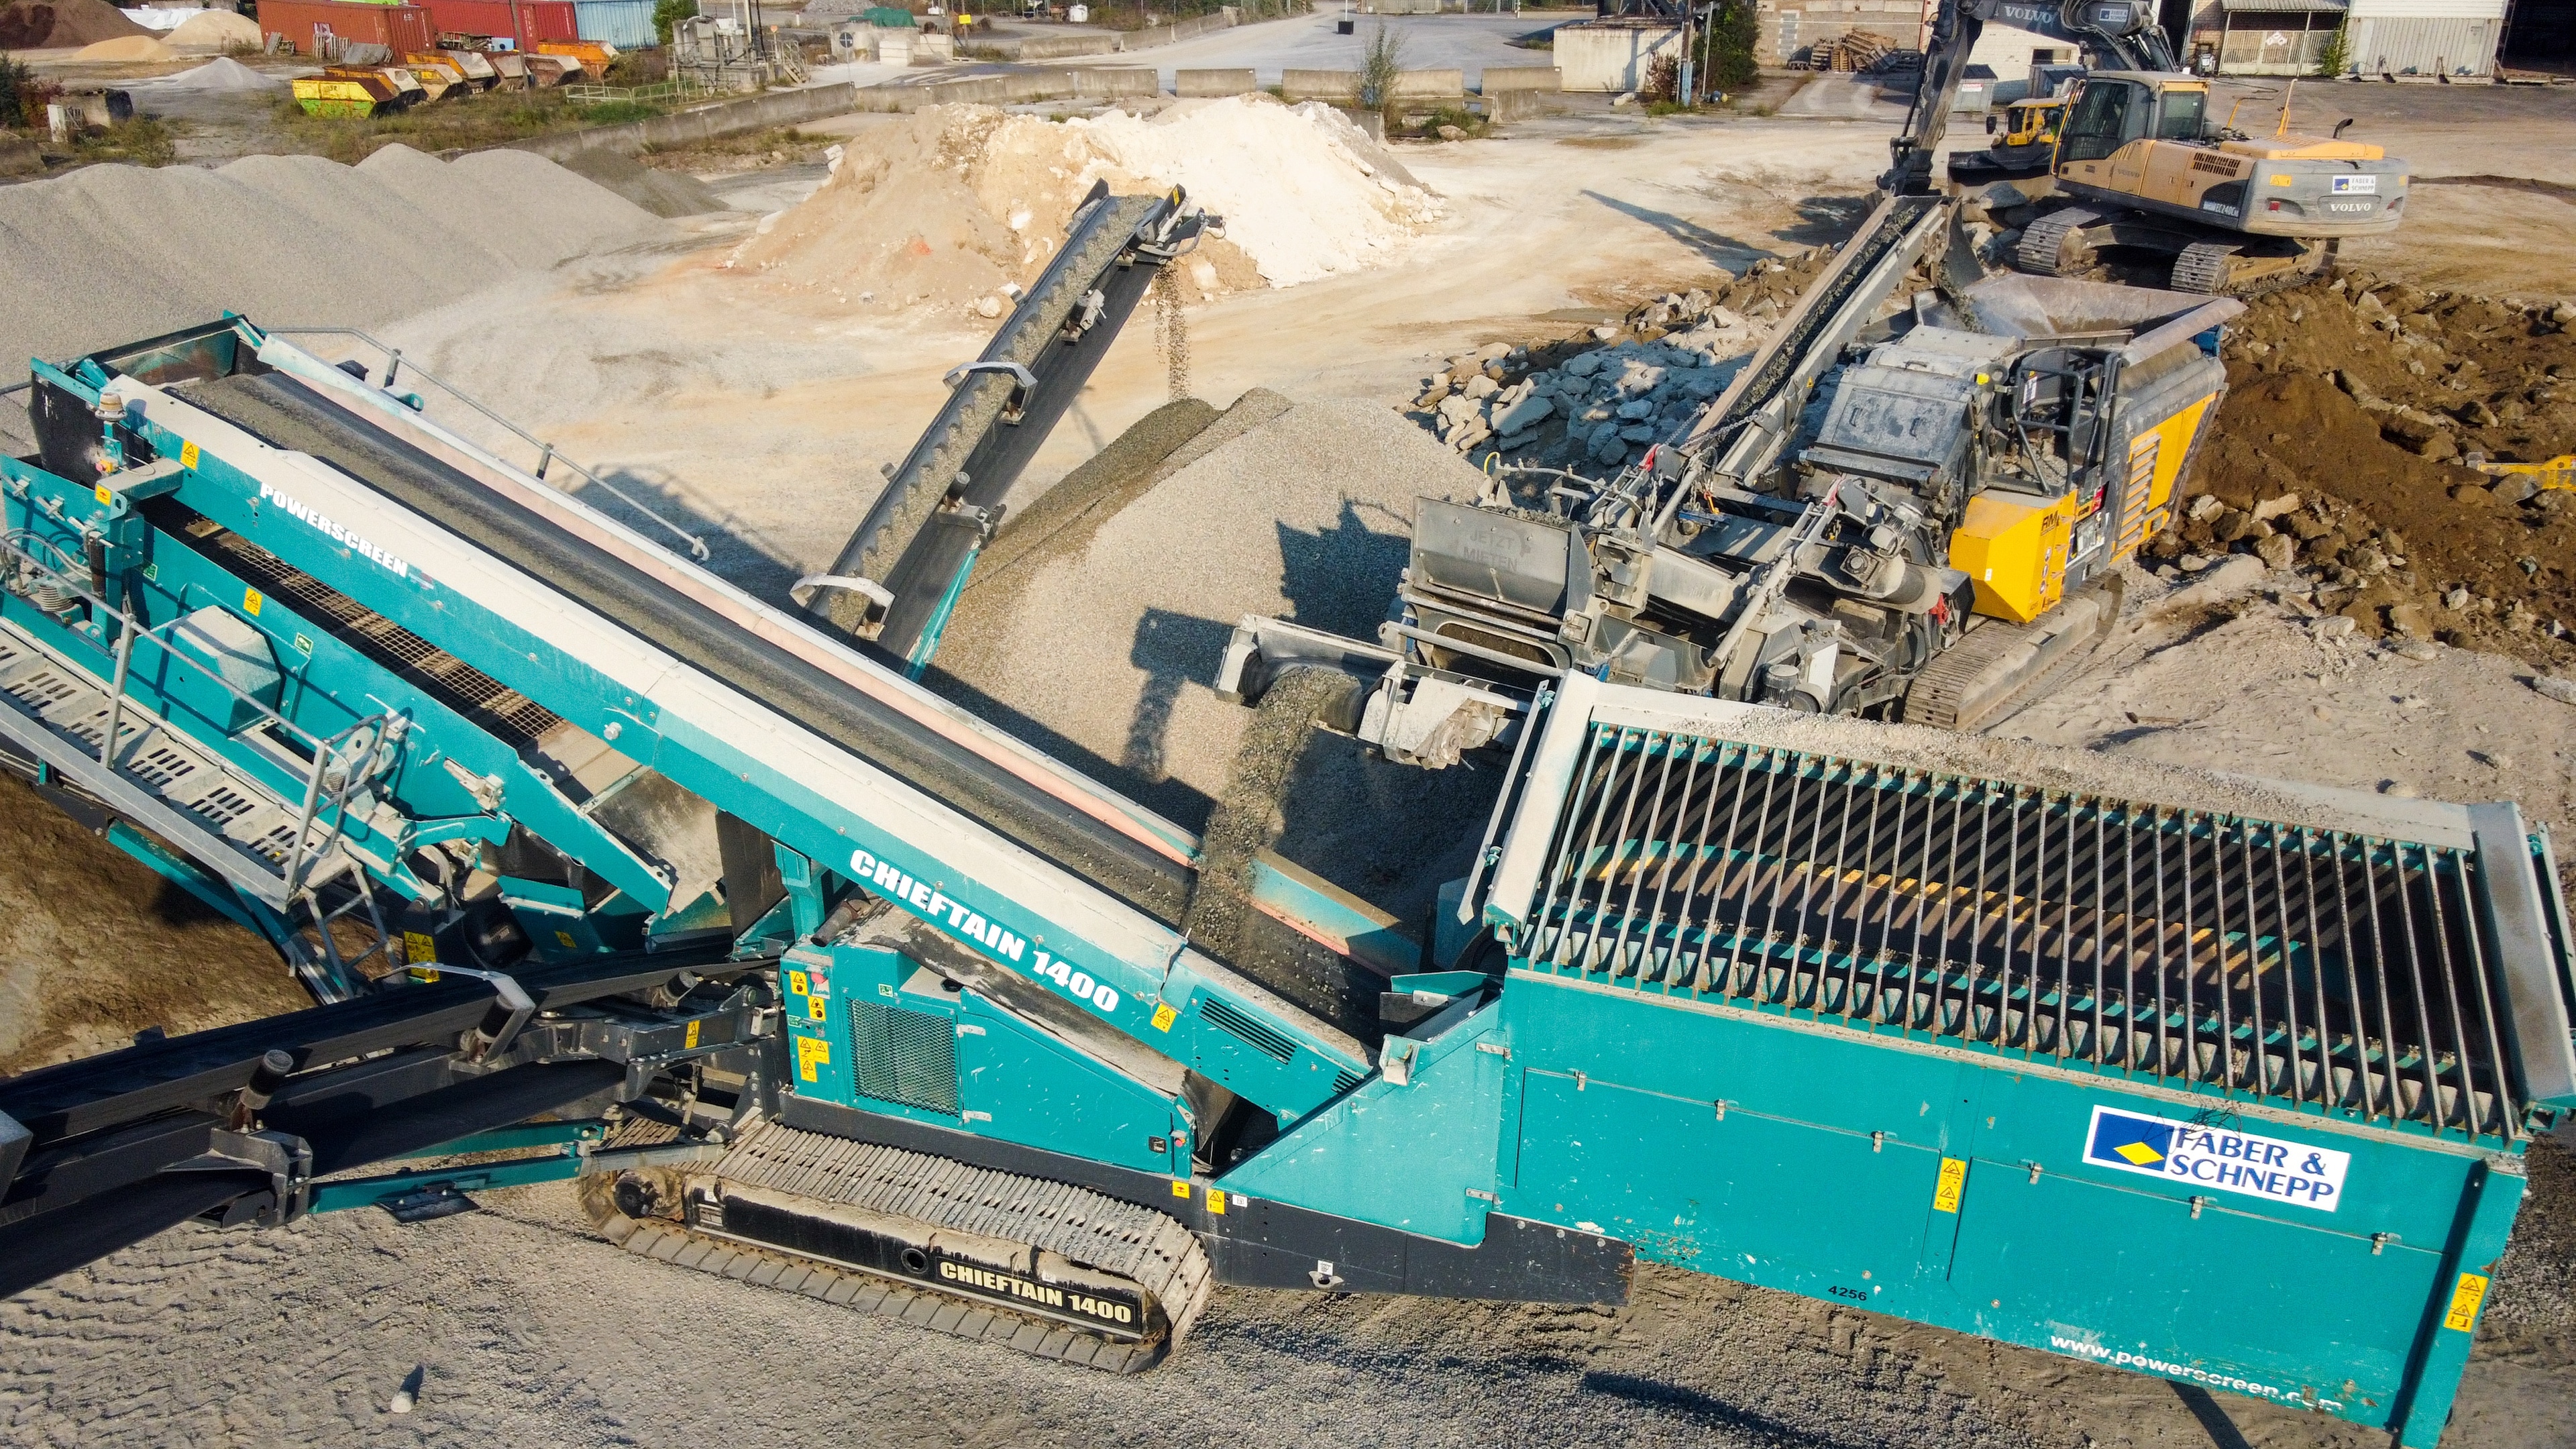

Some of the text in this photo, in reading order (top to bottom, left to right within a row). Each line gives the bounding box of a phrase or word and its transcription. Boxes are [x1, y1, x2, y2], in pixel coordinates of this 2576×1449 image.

[2004, 5, 2052, 23] VOLVO
[2330, 203, 2371, 212] VOLVO
[260, 482, 408, 578] POWERSCREEN
[1470, 529, 1515, 549] JETZT
[1463, 546, 1517, 572] MIETEN
[849, 849, 1120, 1012] CHIEFTAIN 1400
[2176, 1126, 2326, 1177] FABER &
[2170, 1153, 2334, 1202] SCHNEPP
[940, 1261, 1132, 1324] CHIEFTAIN 1400
[1827, 1285, 1868, 1301] 4256
[2050, 1335, 2343, 1411] www.powerscreen.com
